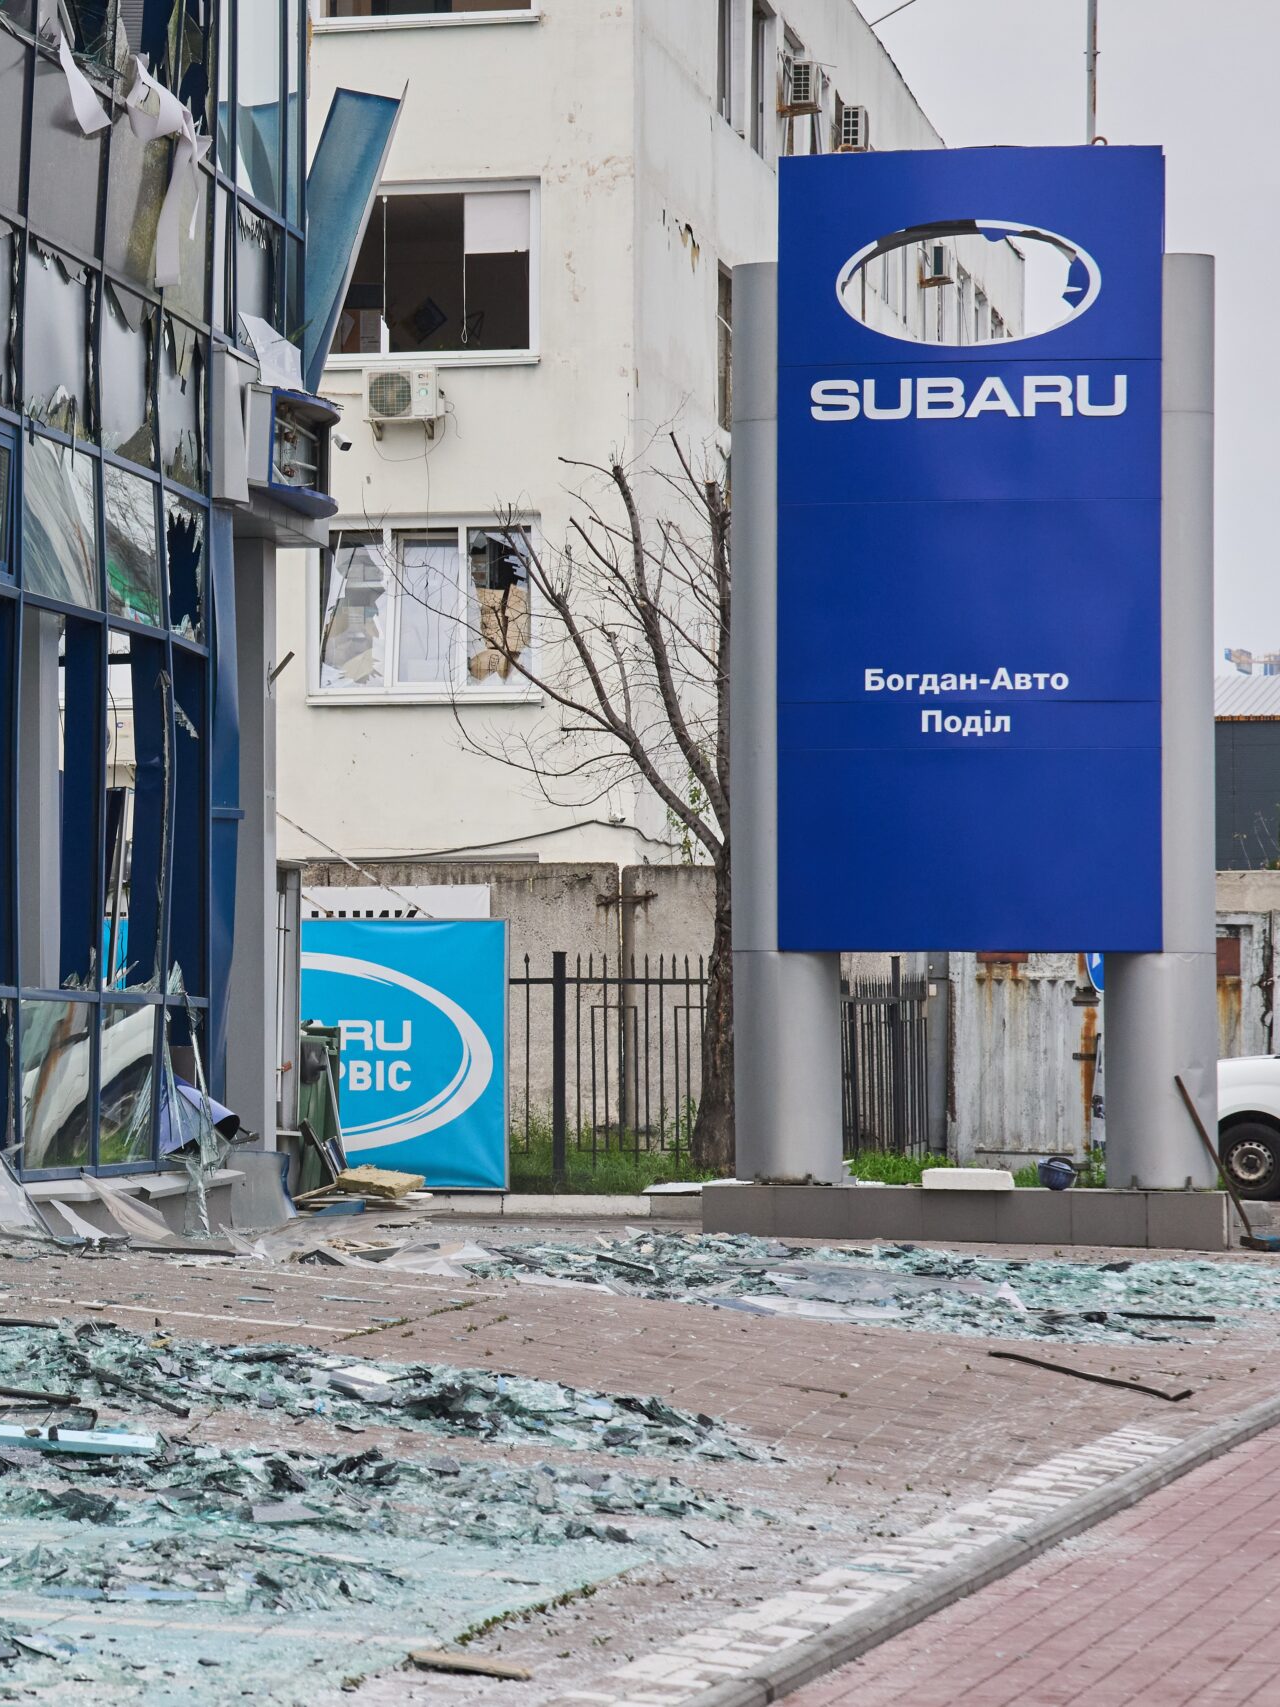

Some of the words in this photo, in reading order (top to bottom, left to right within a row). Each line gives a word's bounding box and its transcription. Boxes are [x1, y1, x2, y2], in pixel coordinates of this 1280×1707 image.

[810, 374, 1127, 421] SUBARU
[864, 667, 1069, 695] Богдан-Авто
[920, 709, 1011, 737] Поділ
[302, 1019, 412, 1051] RU
